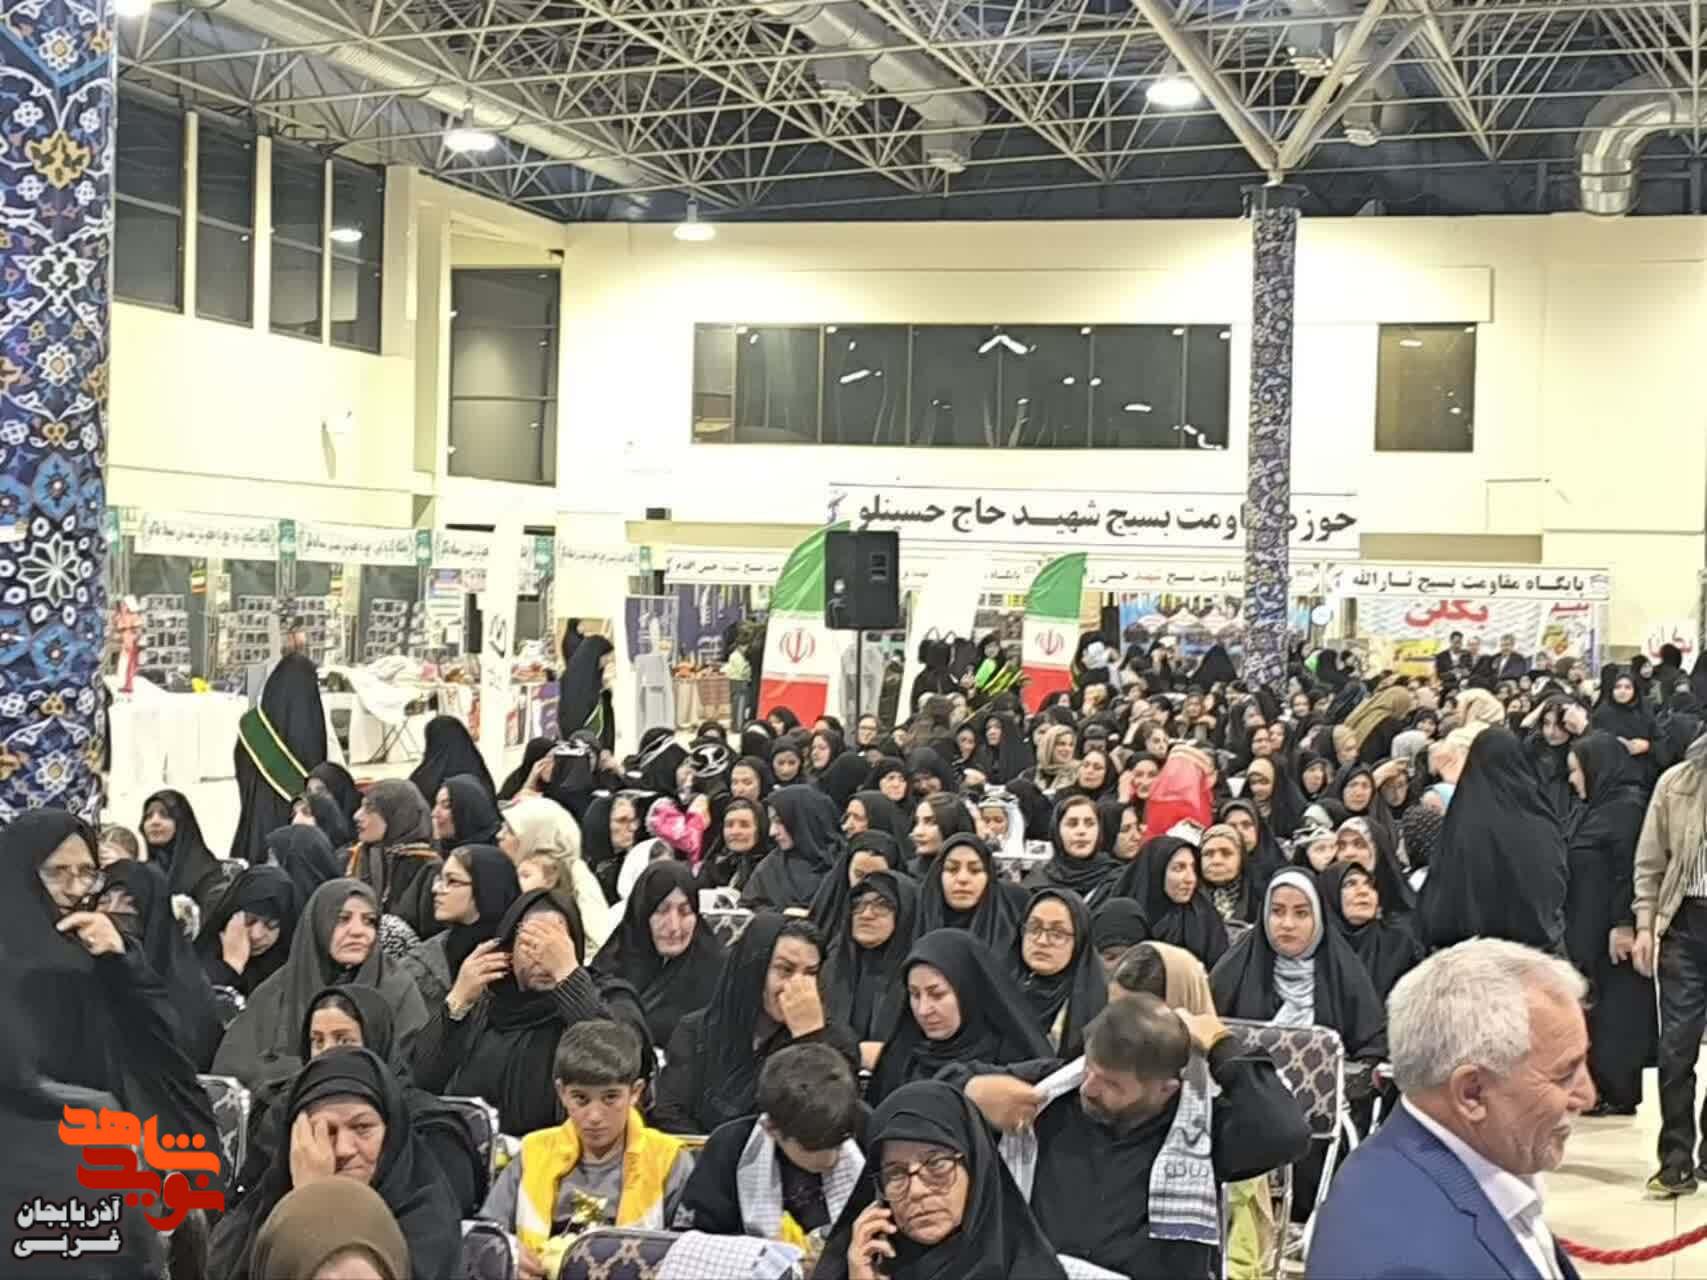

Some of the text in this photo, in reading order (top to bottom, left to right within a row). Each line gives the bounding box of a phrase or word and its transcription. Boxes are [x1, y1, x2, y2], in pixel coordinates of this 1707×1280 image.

[857, 494, 945, 532] حسینلو
[952, 496, 1005, 533] حاج
[1012, 500, 1101, 534] شهید
[1106, 508, 1171, 536] بسیج
[1177, 502, 1252, 541] اومت
[1417, 576, 1456, 594] بسیج
[1462, 573, 1520, 596] مقاومت
